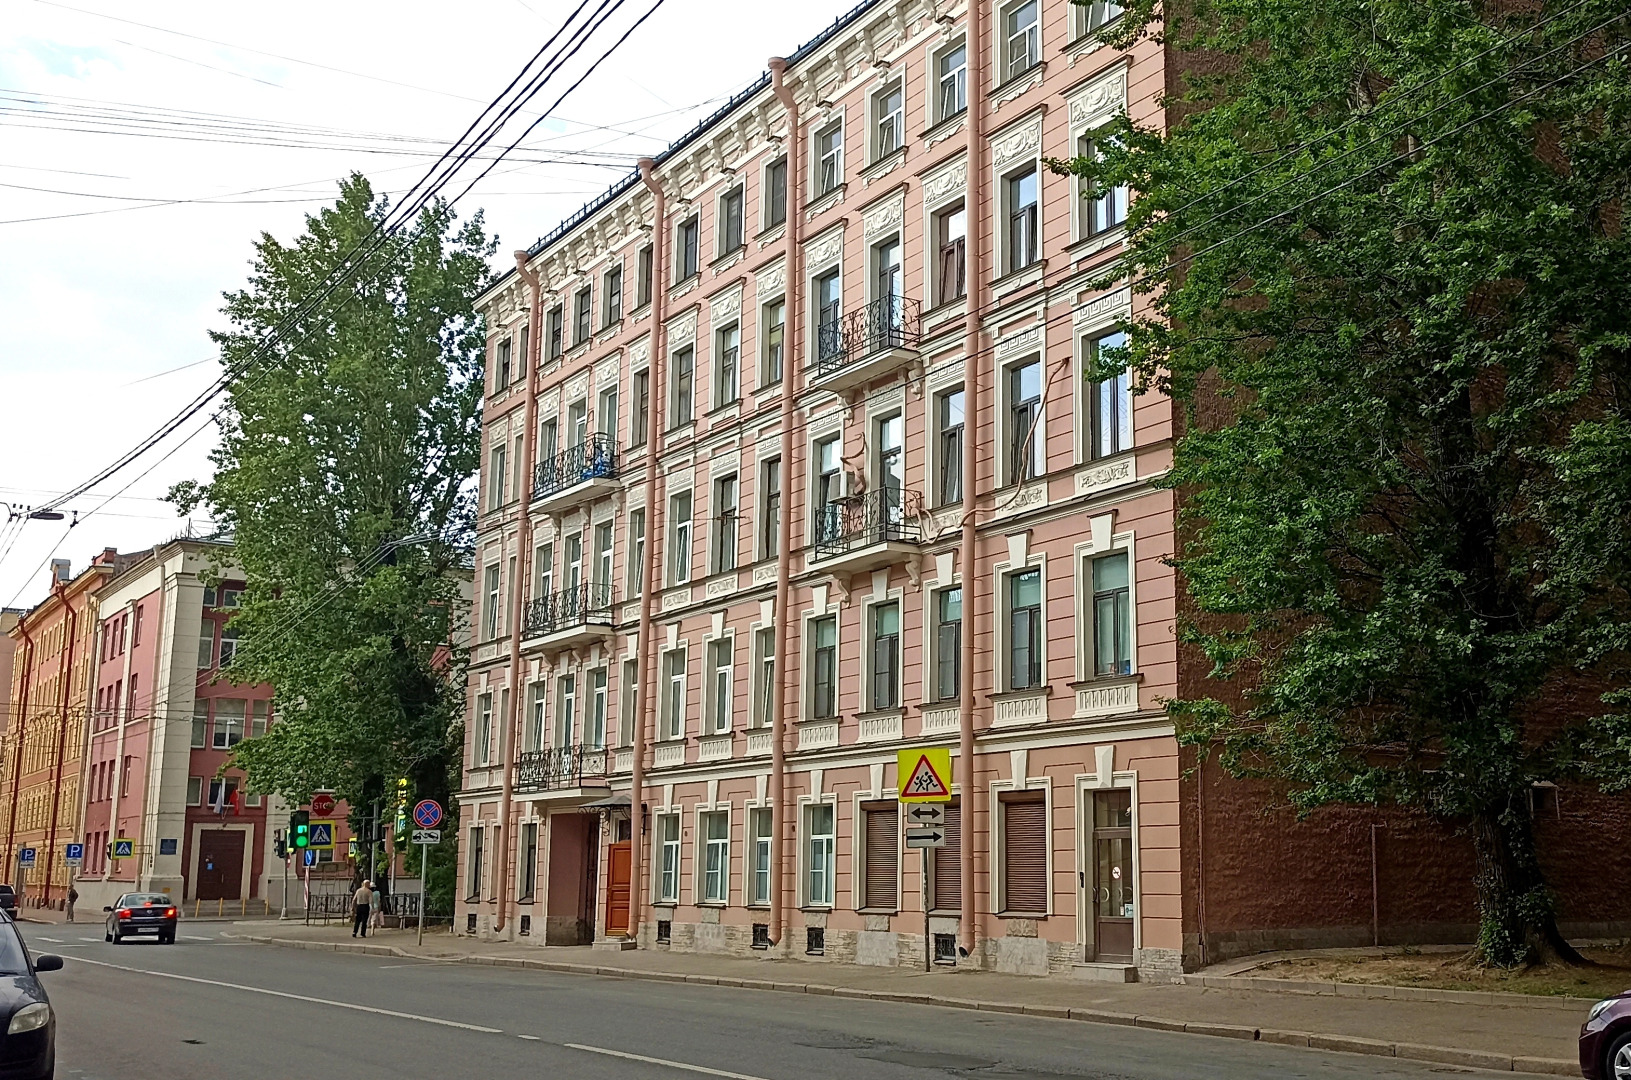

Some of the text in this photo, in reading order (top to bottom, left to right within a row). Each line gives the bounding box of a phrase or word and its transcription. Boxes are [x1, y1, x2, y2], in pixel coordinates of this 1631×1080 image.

[314, 802, 331, 810] STO
[25, 849, 34, 860] P
[70, 845, 80, 857] P
